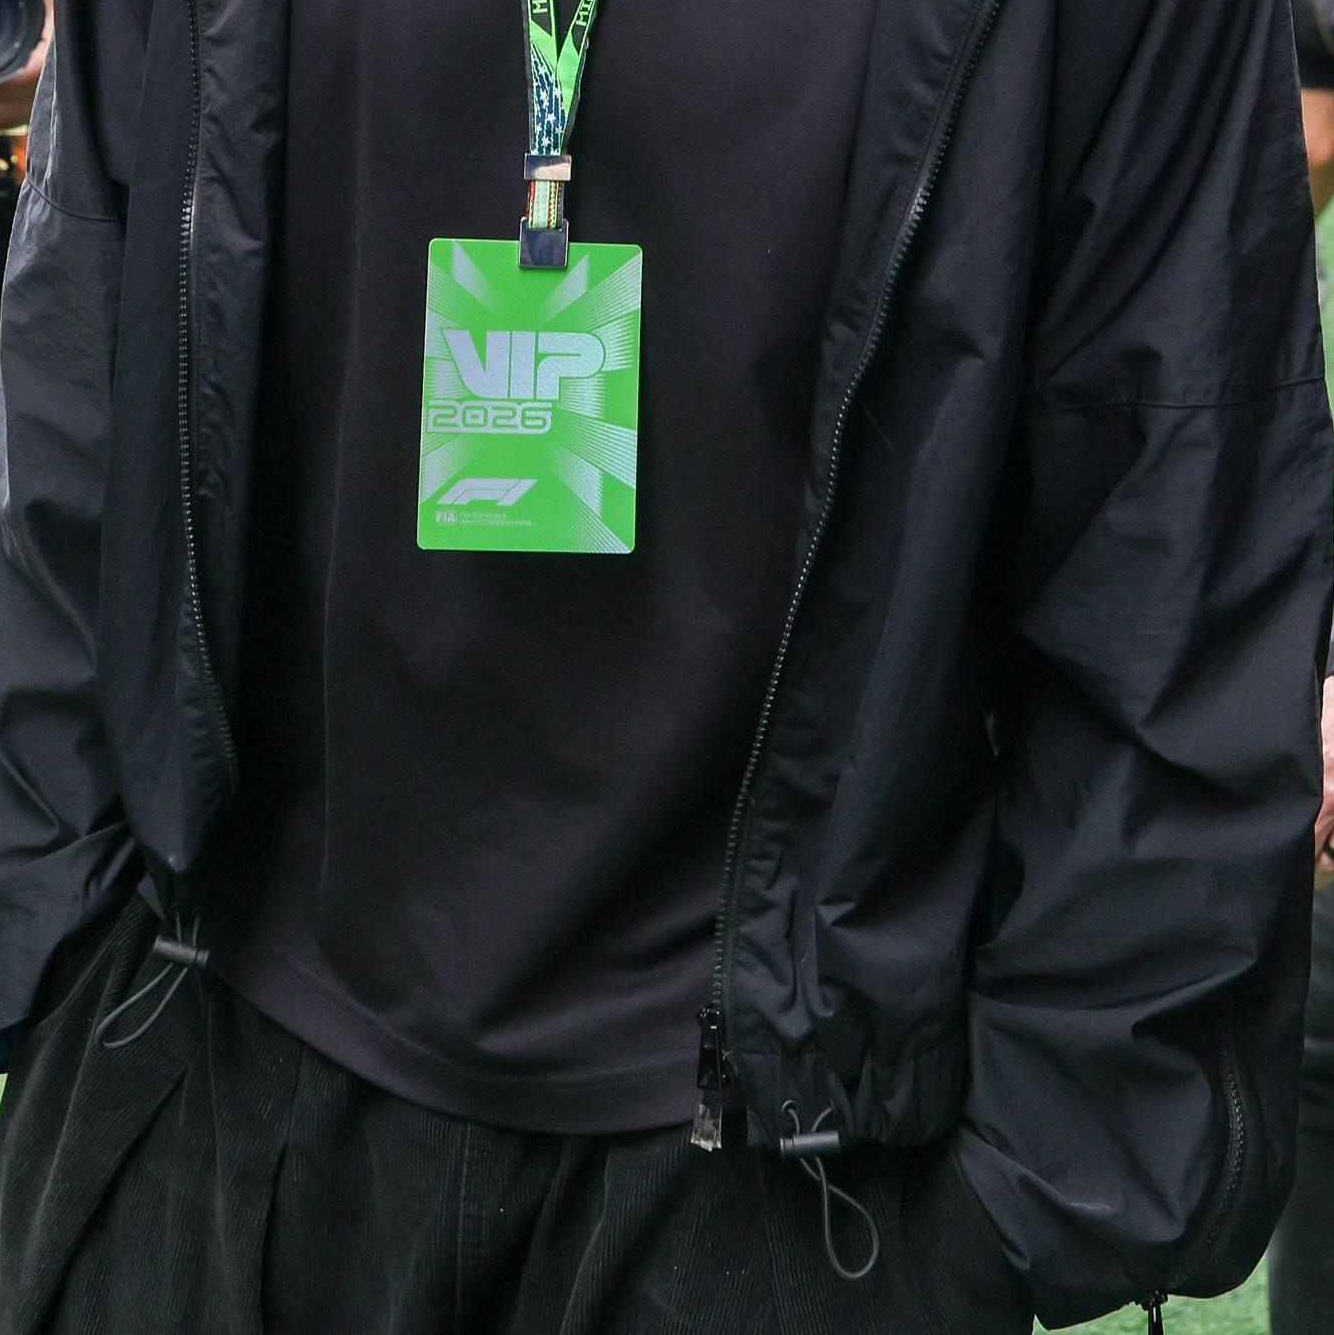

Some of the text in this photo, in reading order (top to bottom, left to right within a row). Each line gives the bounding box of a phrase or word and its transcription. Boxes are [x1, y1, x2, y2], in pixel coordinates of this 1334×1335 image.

[442, 329, 606, 400] VIP
[427, 399, 552, 435] 2026
[436, 478, 538, 506] F1
